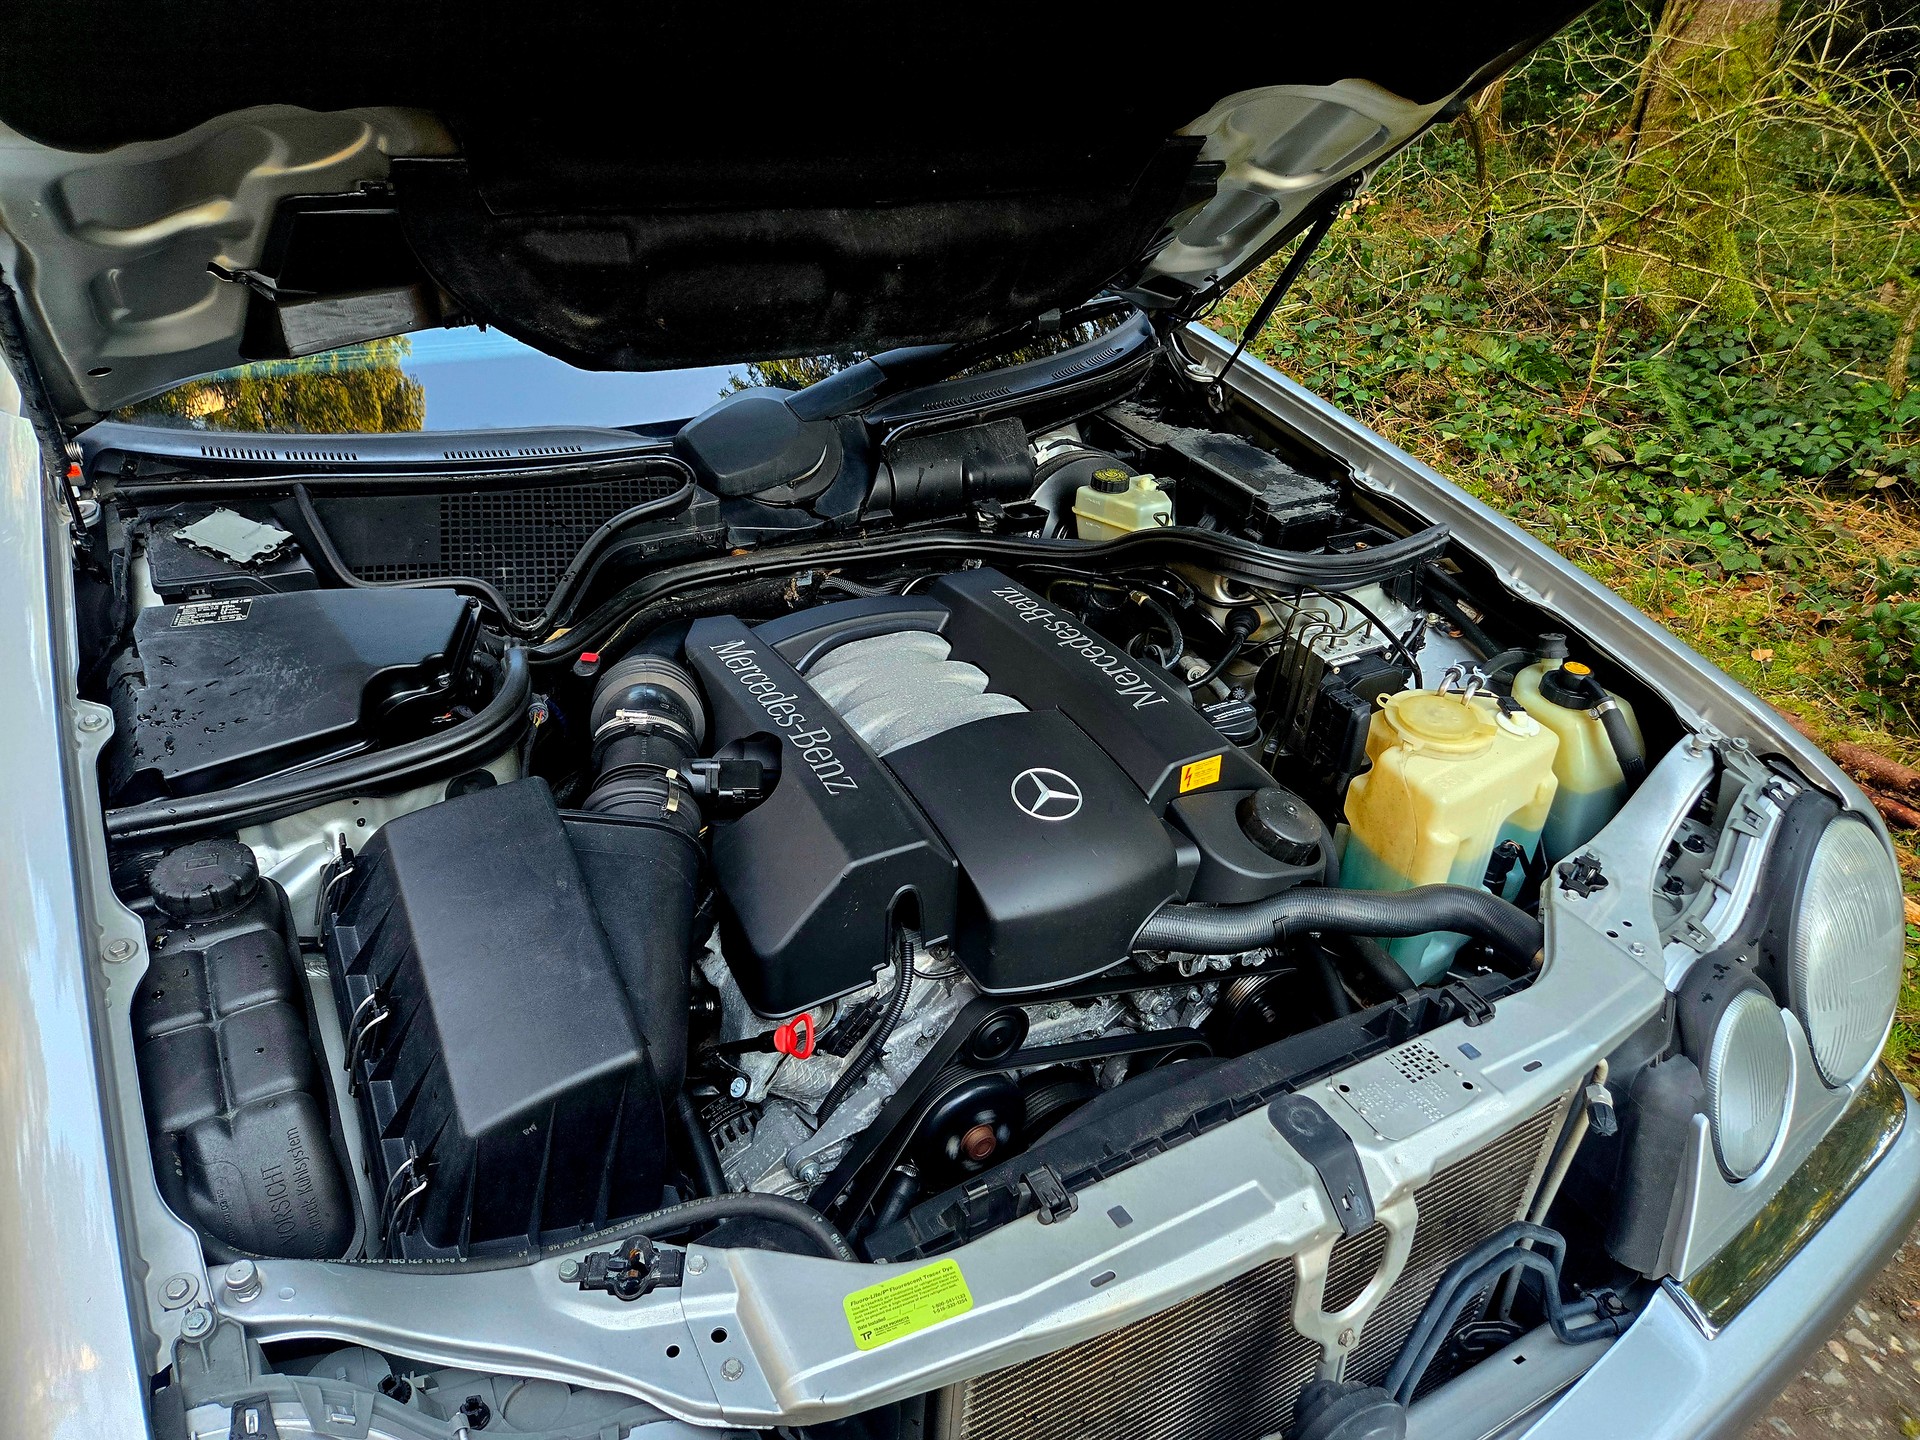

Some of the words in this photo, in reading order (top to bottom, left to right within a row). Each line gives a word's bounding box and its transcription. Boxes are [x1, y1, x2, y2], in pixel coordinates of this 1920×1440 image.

[991, 586, 1169, 710] Mercedes-Benz
[708, 639, 859, 795] Mercedes-Benz
[260, 1164, 298, 1245] VORSICHT
[889, 1276, 922, 1292] Fluorescent
[923, 1269, 942, 1279] Tracer
[941, 1265, 953, 1273] Dye
